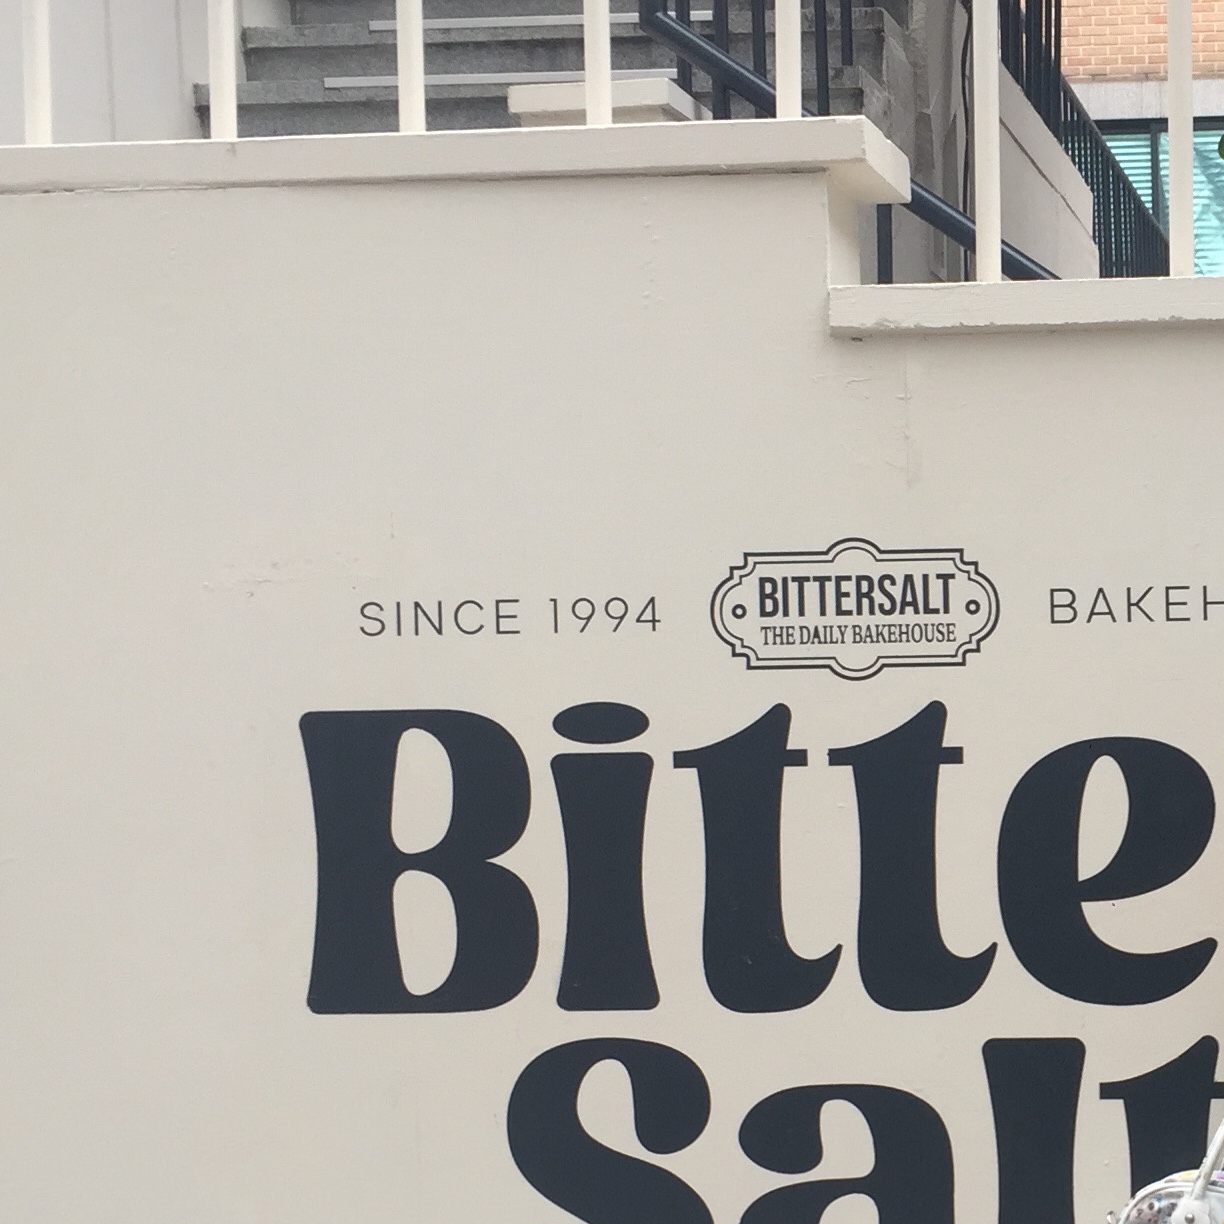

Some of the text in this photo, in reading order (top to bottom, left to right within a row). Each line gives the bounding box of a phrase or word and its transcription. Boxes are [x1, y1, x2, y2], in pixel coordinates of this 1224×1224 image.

[758, 573, 956, 618] BITTERSALT
[359, 596, 662, 637] SINCE 1994
[760, 622, 957, 646] THE DAILY BAKEHOUSE
